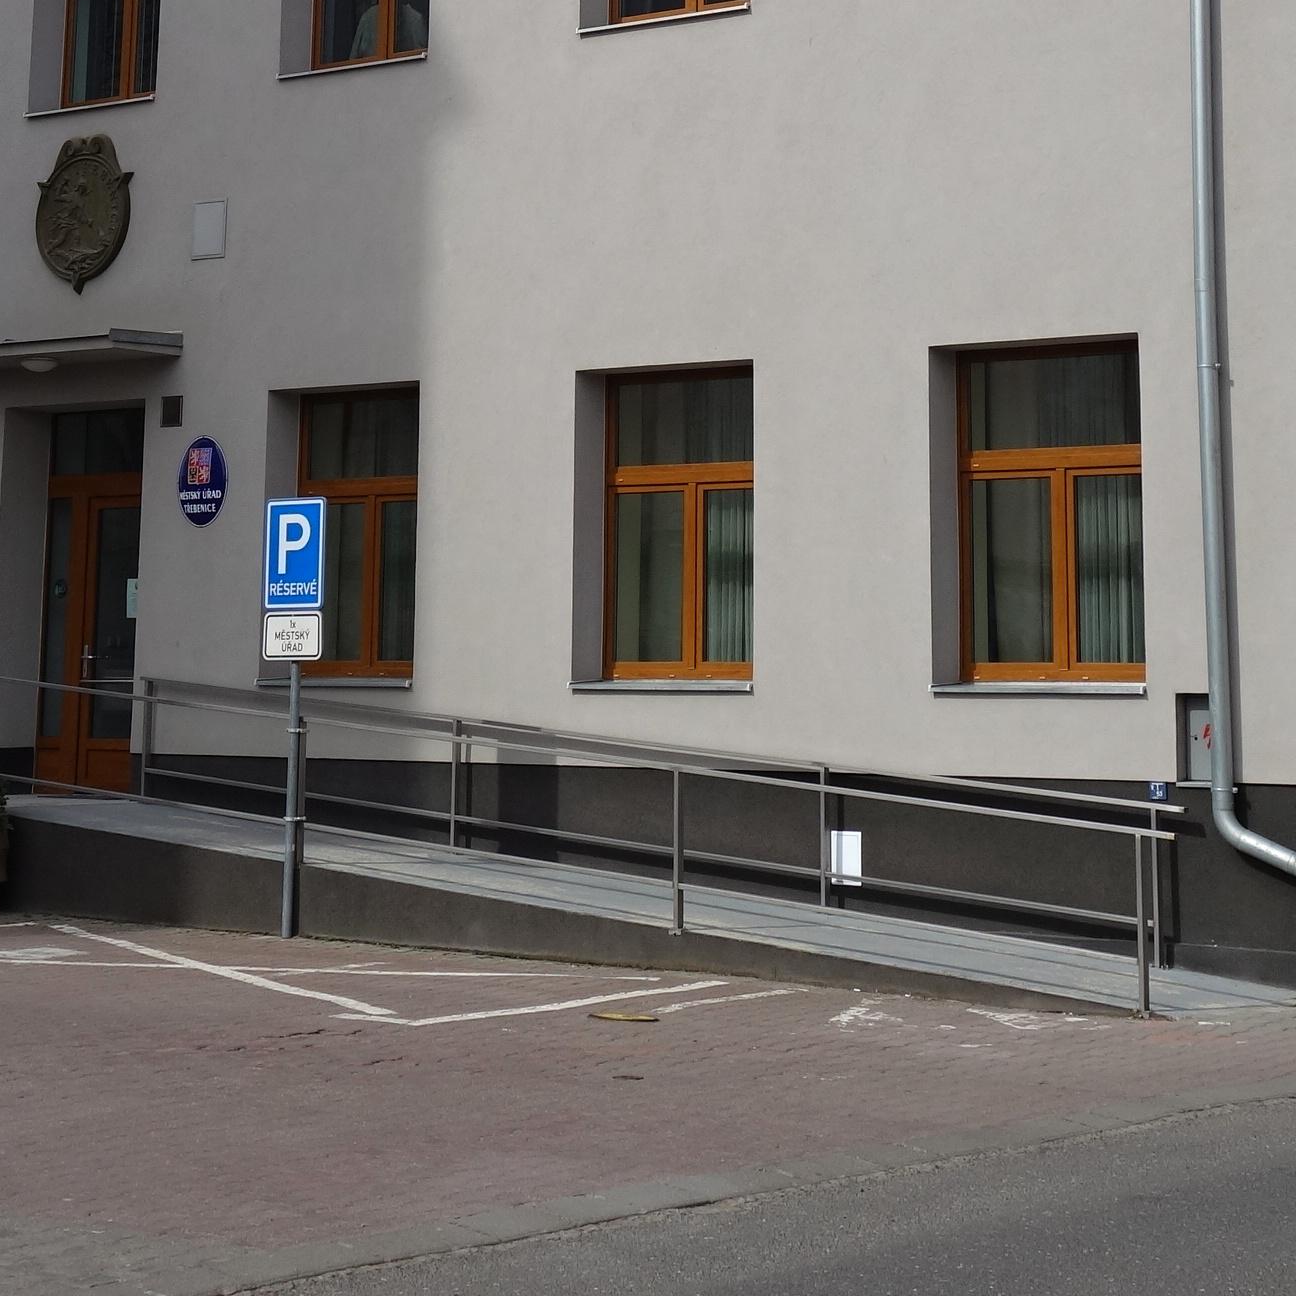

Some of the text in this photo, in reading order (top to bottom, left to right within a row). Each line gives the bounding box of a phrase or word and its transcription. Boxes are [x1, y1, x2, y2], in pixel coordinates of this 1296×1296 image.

[179, 488, 222, 500] MĚSTSKÝ ÚŘAD
[184, 502, 216, 513] TŘEBENICE
[278, 513, 311, 575] P
[269, 579, 317, 597] RÉSERVÉ
[289, 619, 297, 629] 1x
[274, 628, 310, 641] MĚSTSKÝ
[281, 641, 303, 652] ÚŘAD
